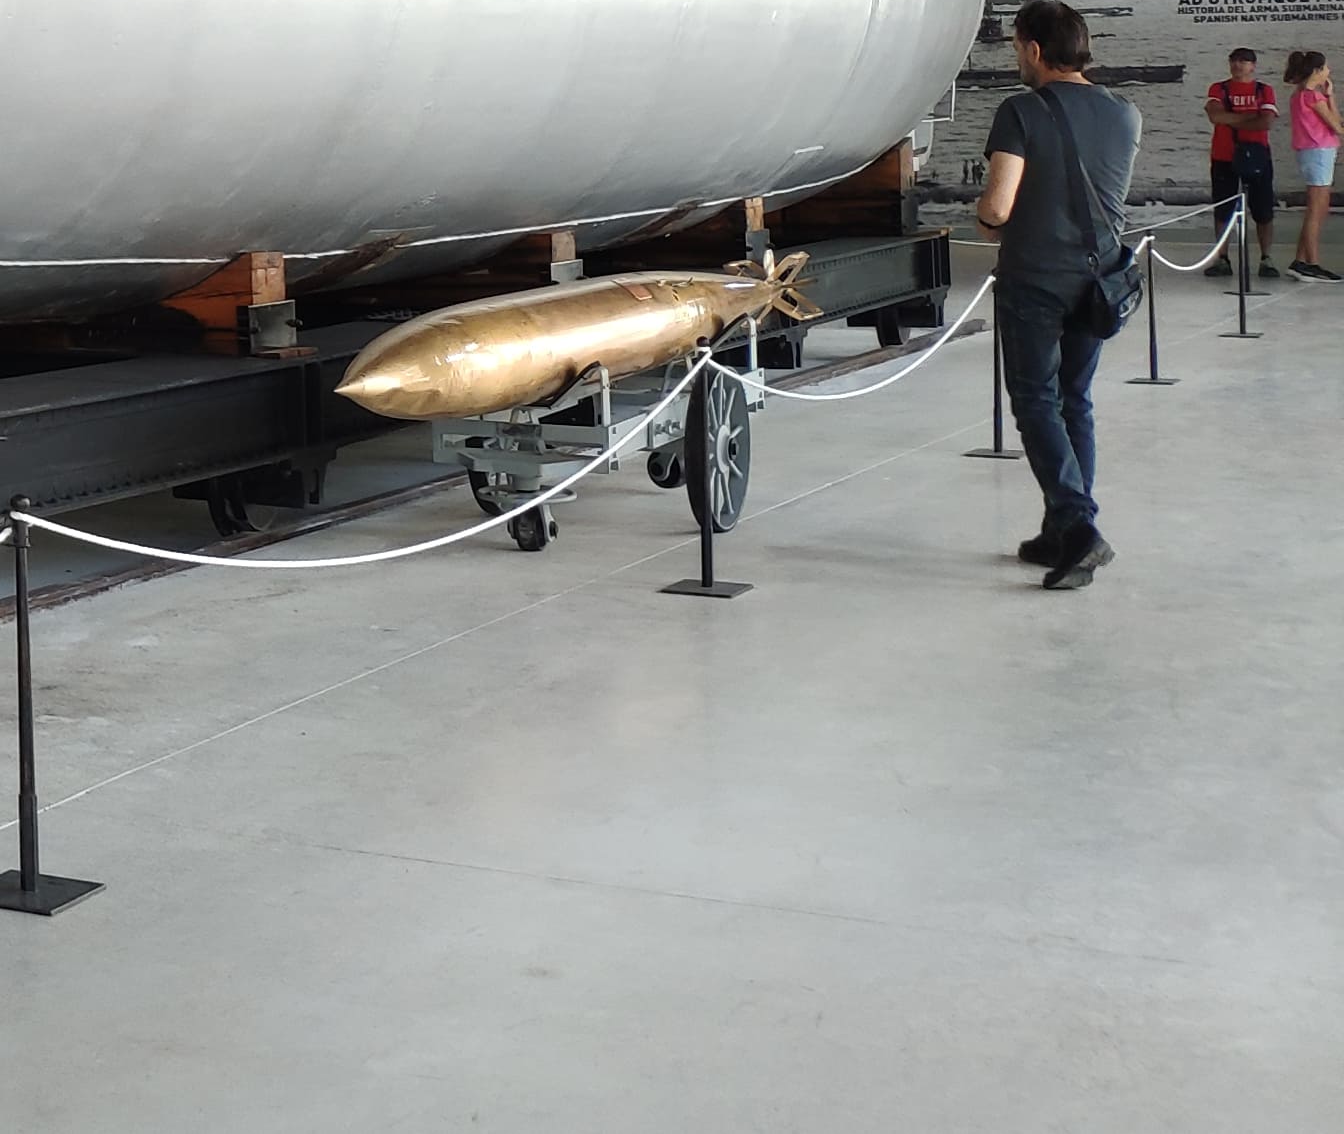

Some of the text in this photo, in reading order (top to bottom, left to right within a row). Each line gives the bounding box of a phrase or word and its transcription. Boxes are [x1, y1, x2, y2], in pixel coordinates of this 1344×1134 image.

[1177, 6, 1225, 14] HISTORIA
[1227, 5, 1247, 14] DEL
[1249, 5, 1280, 13] ARMA
[1193, 12, 1339, 23] SPANISH NAVY SUBMARINES
